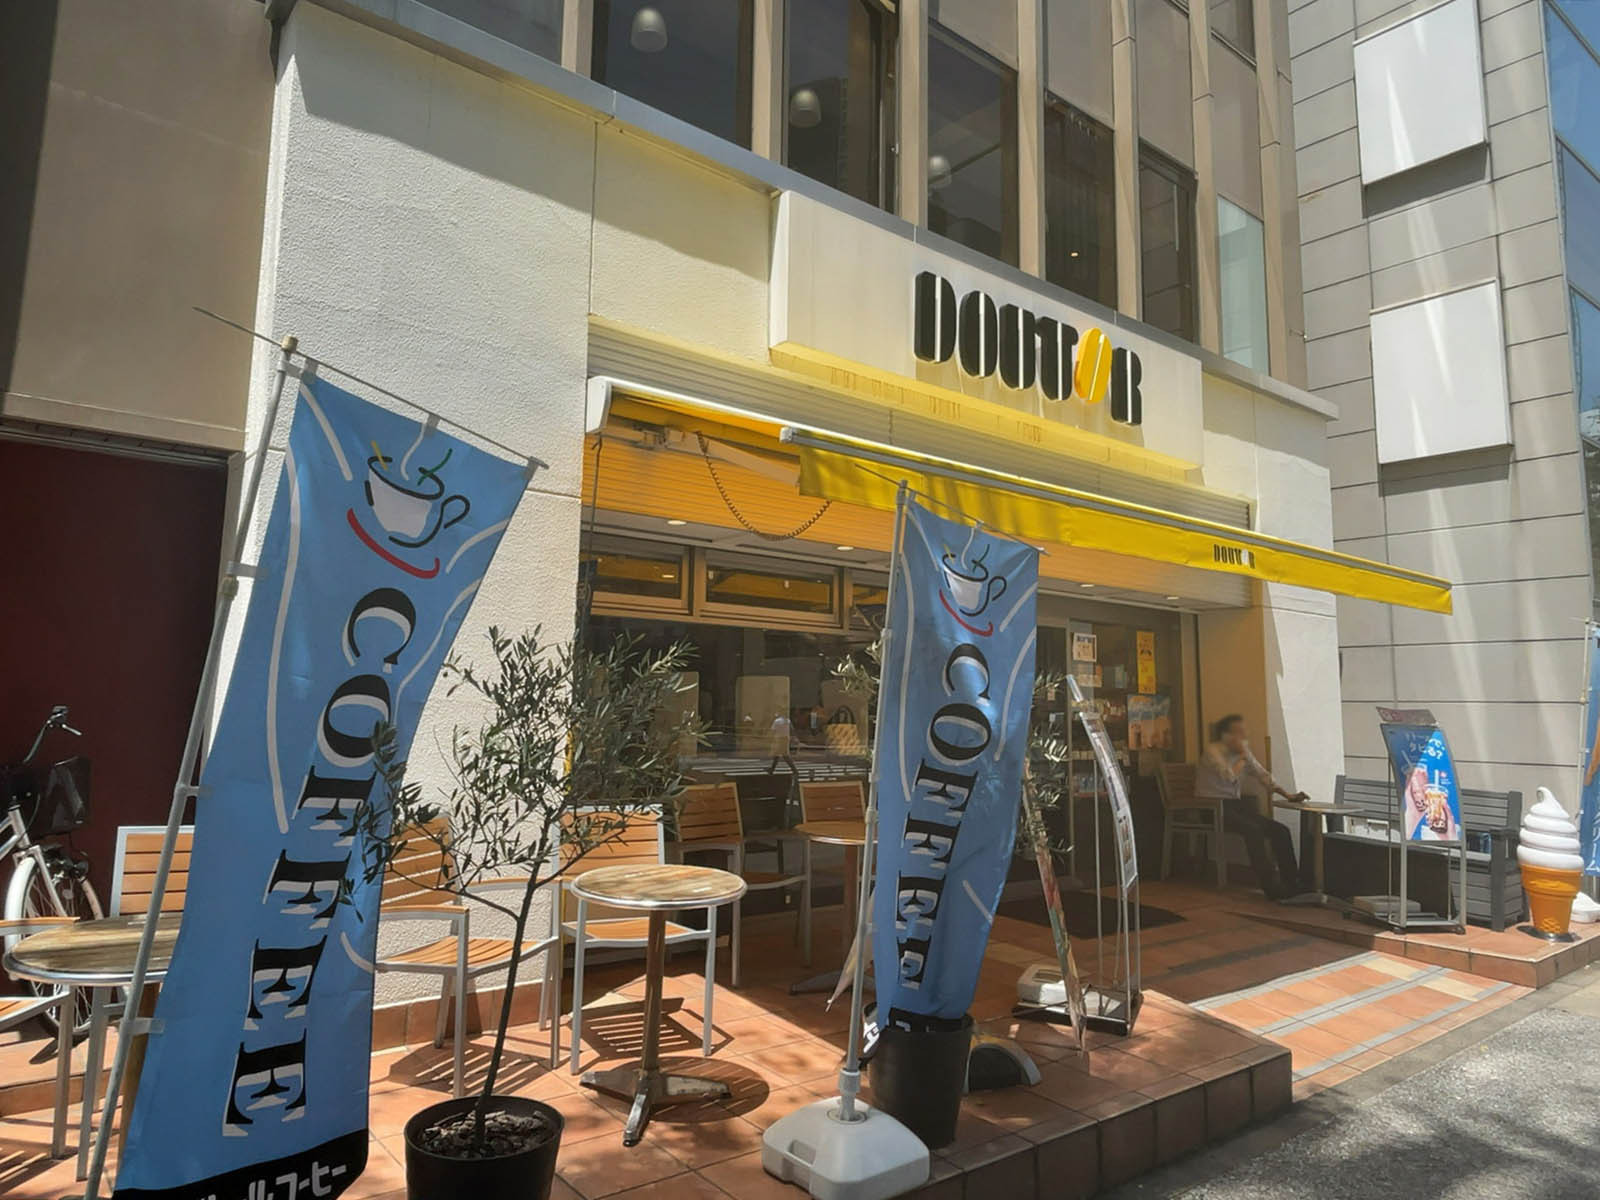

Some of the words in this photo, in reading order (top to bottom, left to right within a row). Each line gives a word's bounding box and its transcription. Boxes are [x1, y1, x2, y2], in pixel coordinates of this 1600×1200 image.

[914, 271, 1142, 426] DOUTOR
[222, 587, 416, 1136] COFFEE
[896, 643, 992, 989] COFFEE
